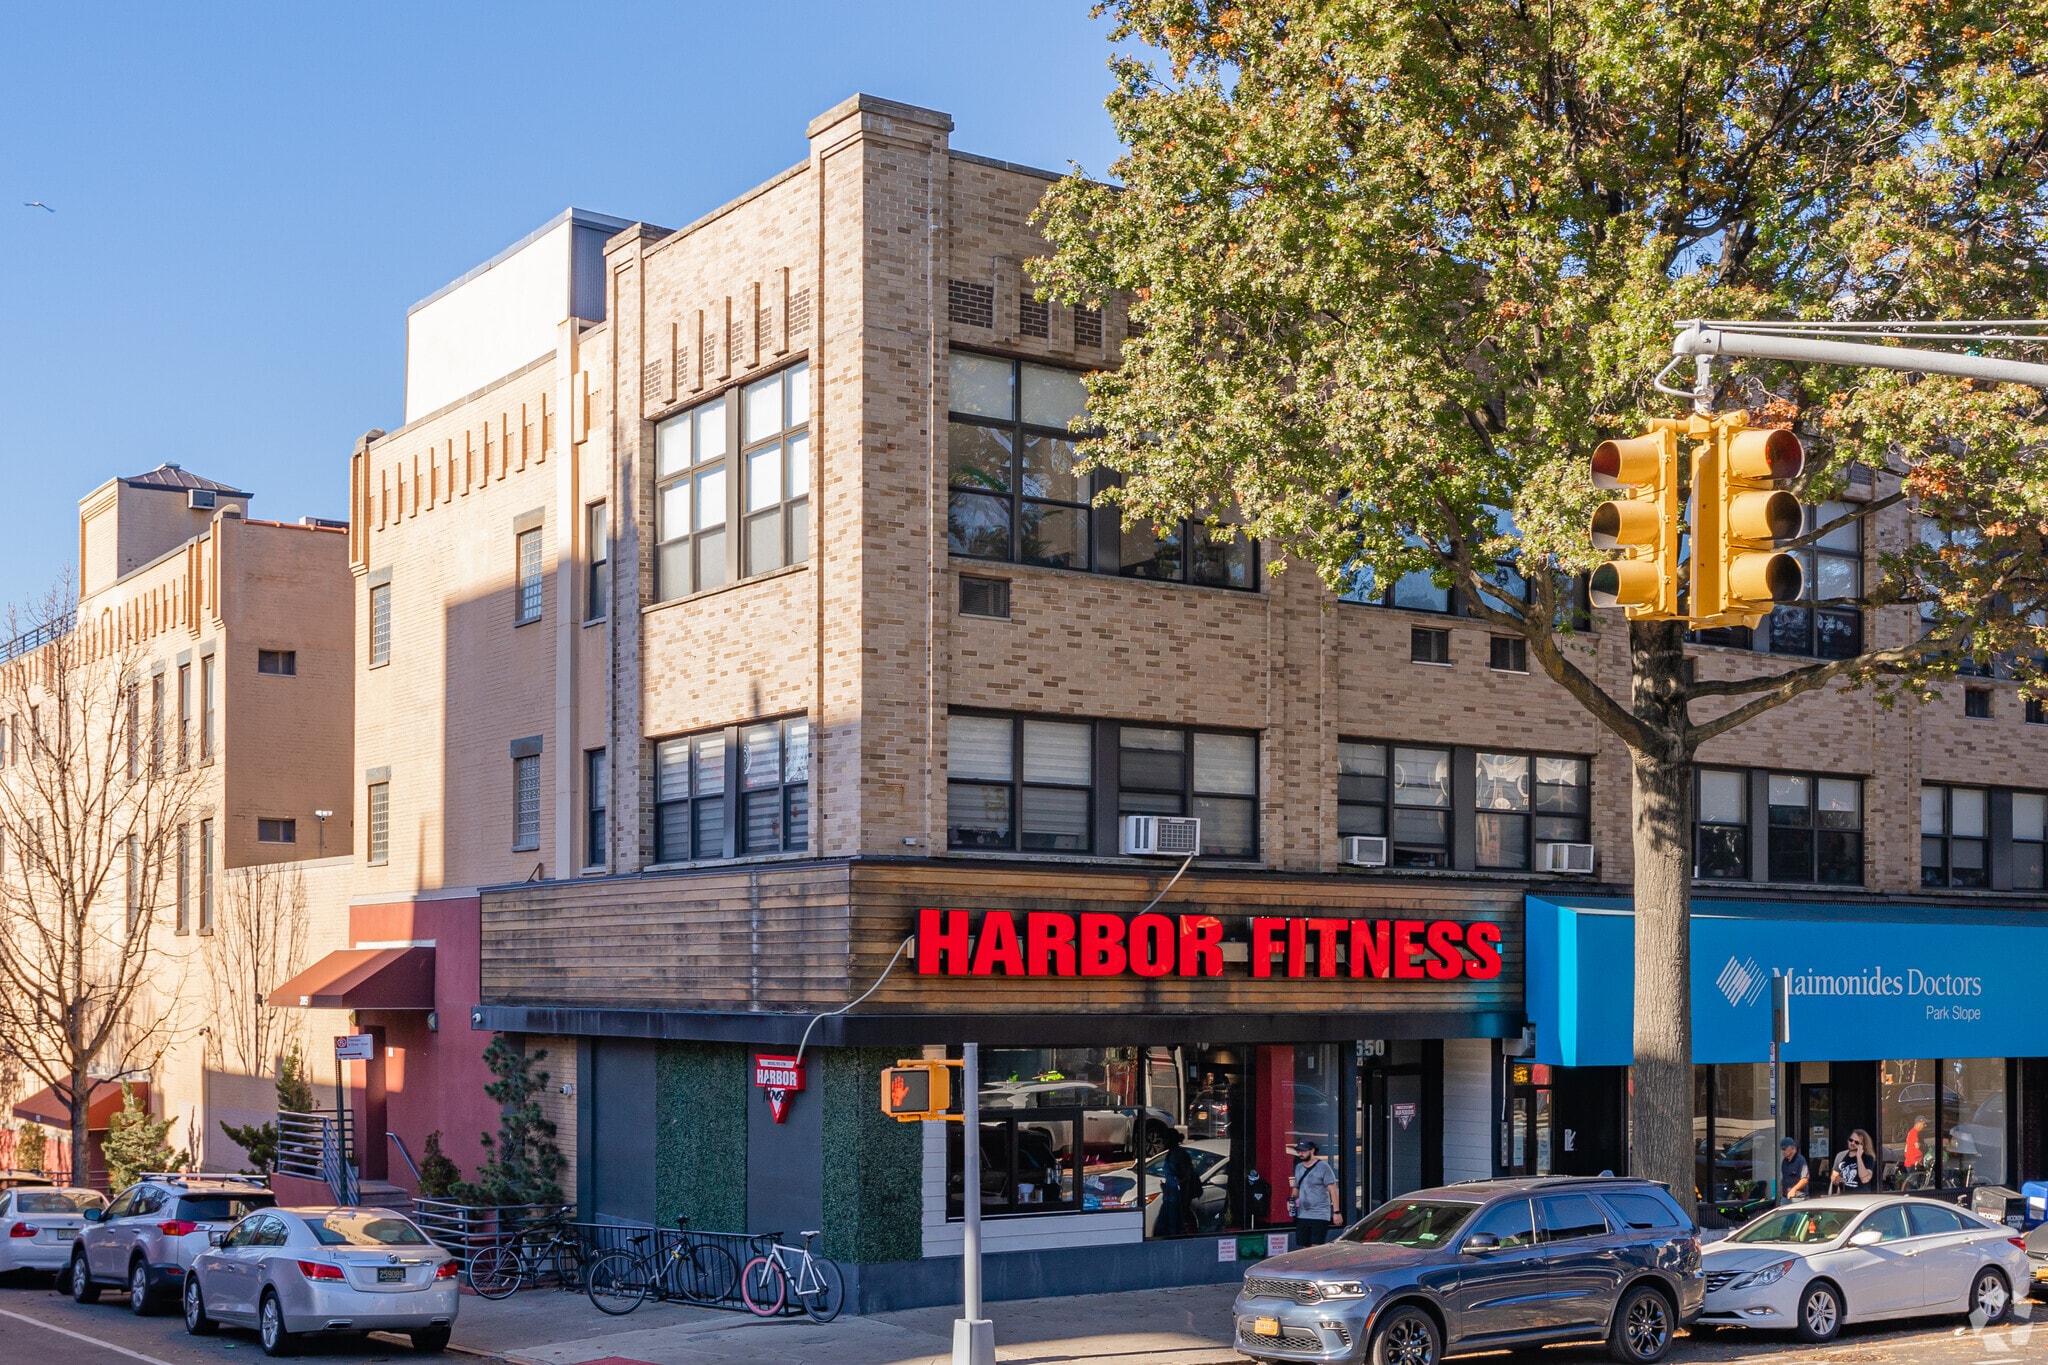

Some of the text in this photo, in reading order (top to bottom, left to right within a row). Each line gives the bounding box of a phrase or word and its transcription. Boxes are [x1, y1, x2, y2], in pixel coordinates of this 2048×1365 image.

[917, 908, 1503, 980] HARBOR FITNESS
[1907, 968, 1982, 996] Doctors
[1926, 1005, 1981, 1022] Park Slope
[1356, 1040, 1385, 1057] 550
[757, 1069, 797, 1086] HARBOR
